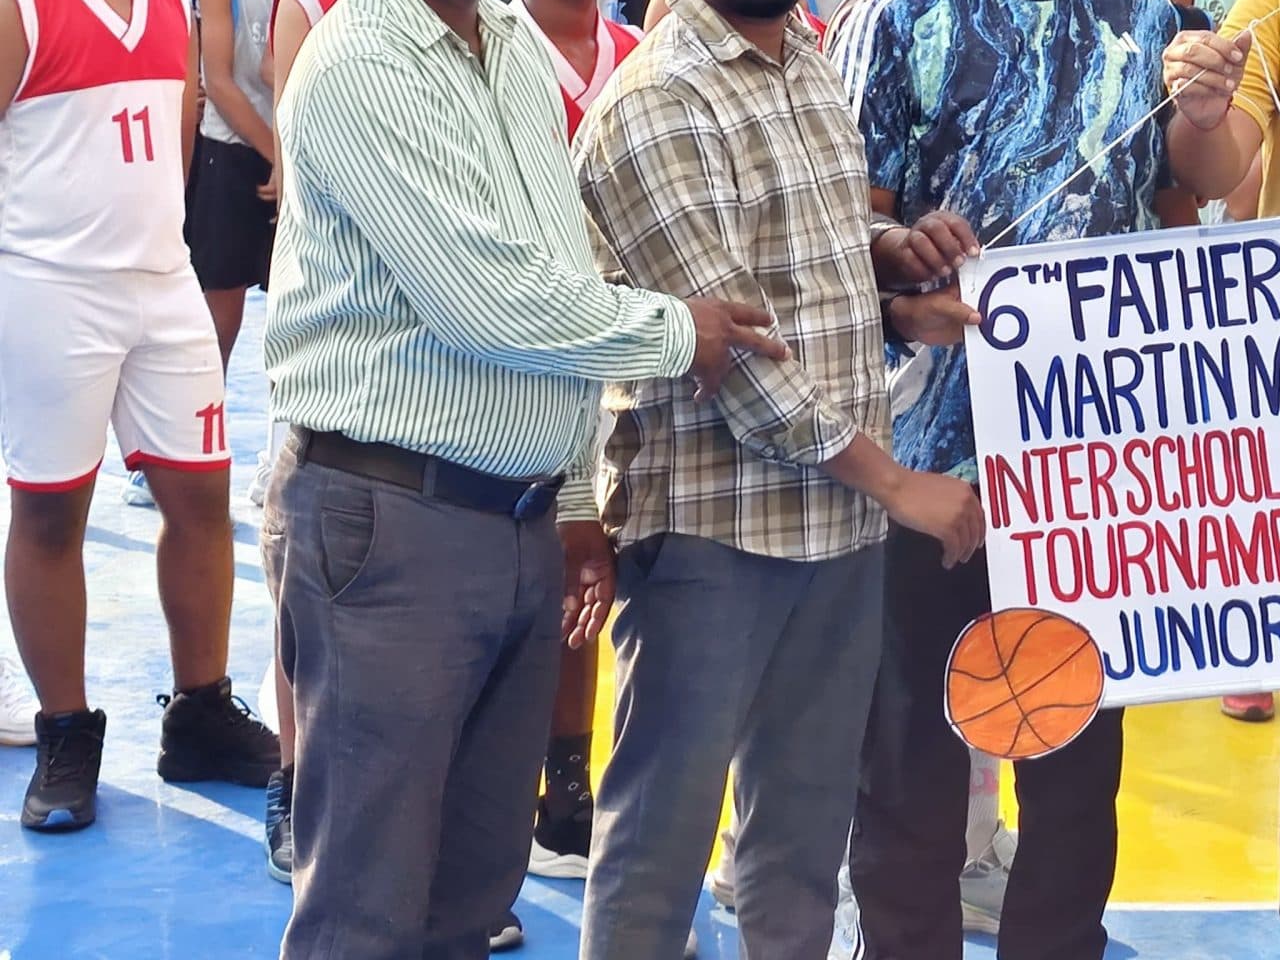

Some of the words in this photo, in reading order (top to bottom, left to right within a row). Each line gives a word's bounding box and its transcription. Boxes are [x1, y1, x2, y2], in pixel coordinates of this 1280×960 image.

[111, 105, 154, 163] 11
[976, 262, 1062, 351] 6TH
[1014, 338, 1237, 442] MARTIN
[195, 400, 226, 454] 11
